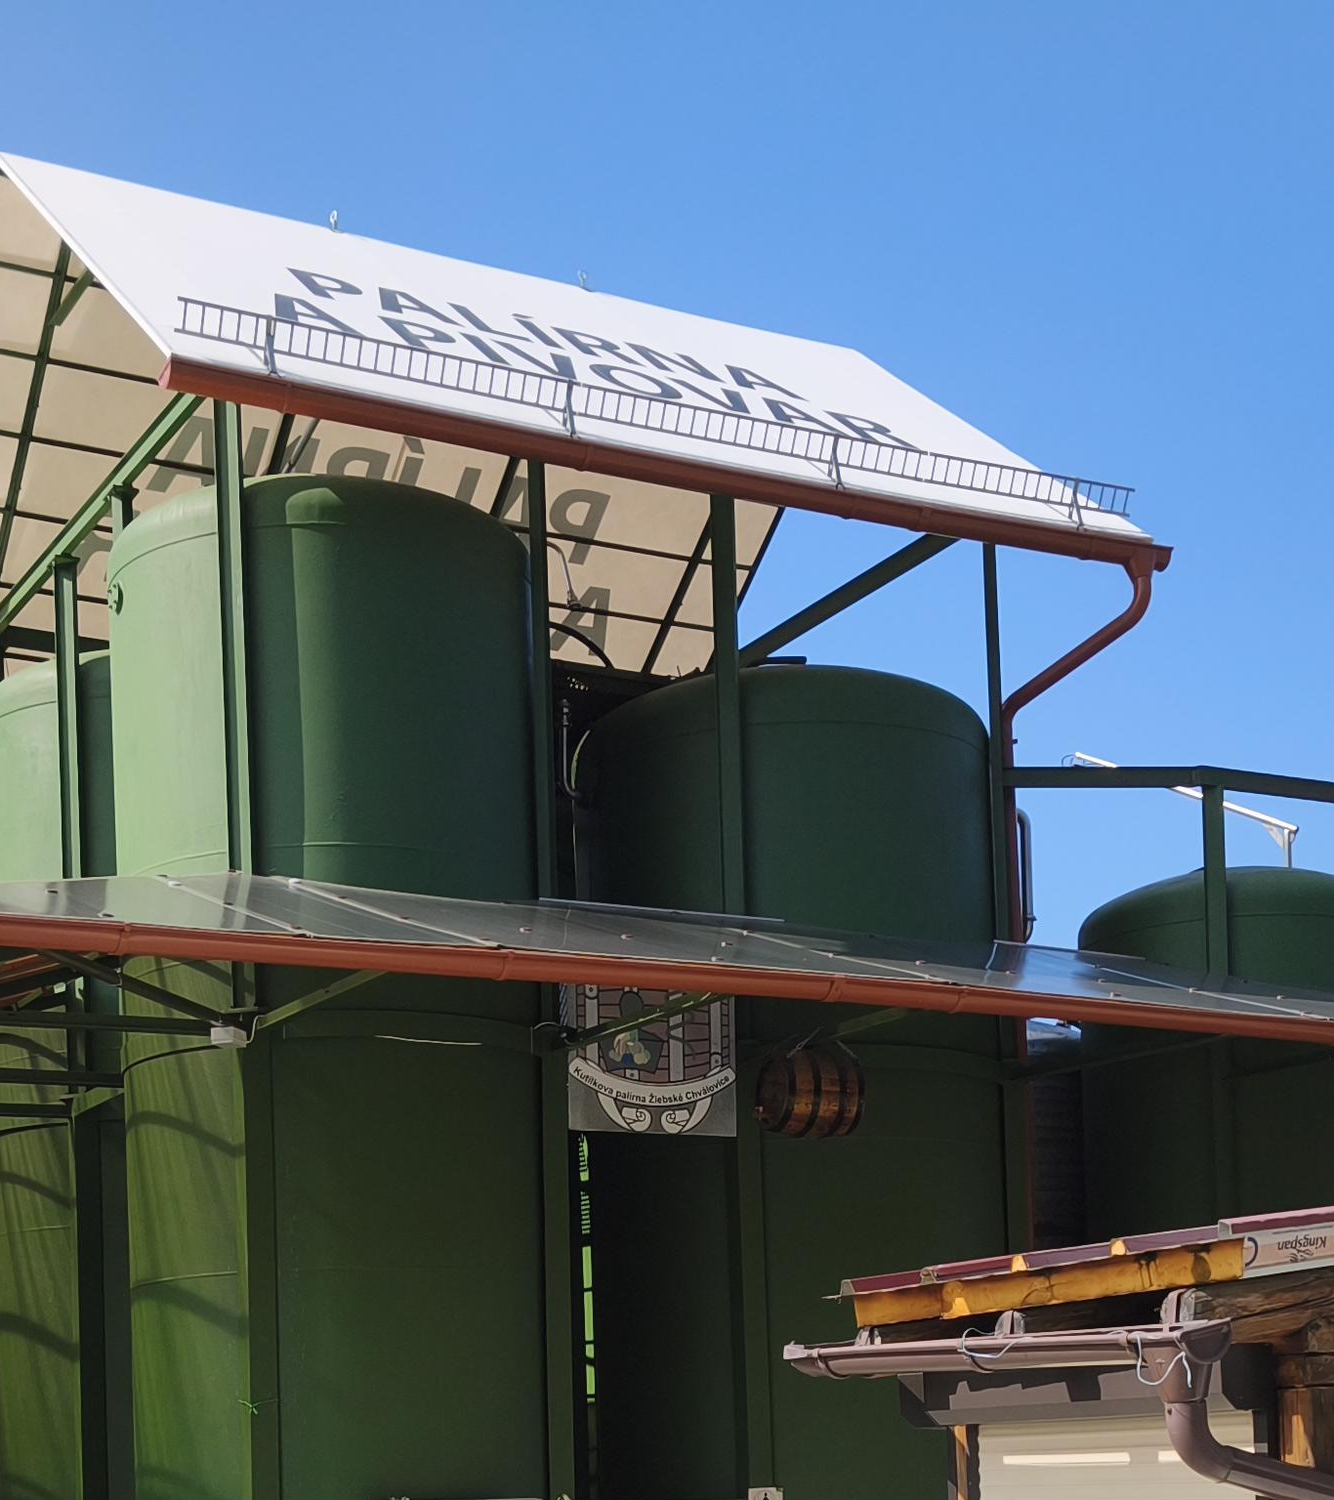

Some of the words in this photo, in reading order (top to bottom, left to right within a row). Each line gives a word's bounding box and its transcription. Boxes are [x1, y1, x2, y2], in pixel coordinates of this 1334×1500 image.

[274, 292, 365, 338] A
[378, 315, 923, 449] PIVOVAR
[288, 267, 809, 402] PALÍRNA
[1278, 1234, 1327, 1251] Kingspan
